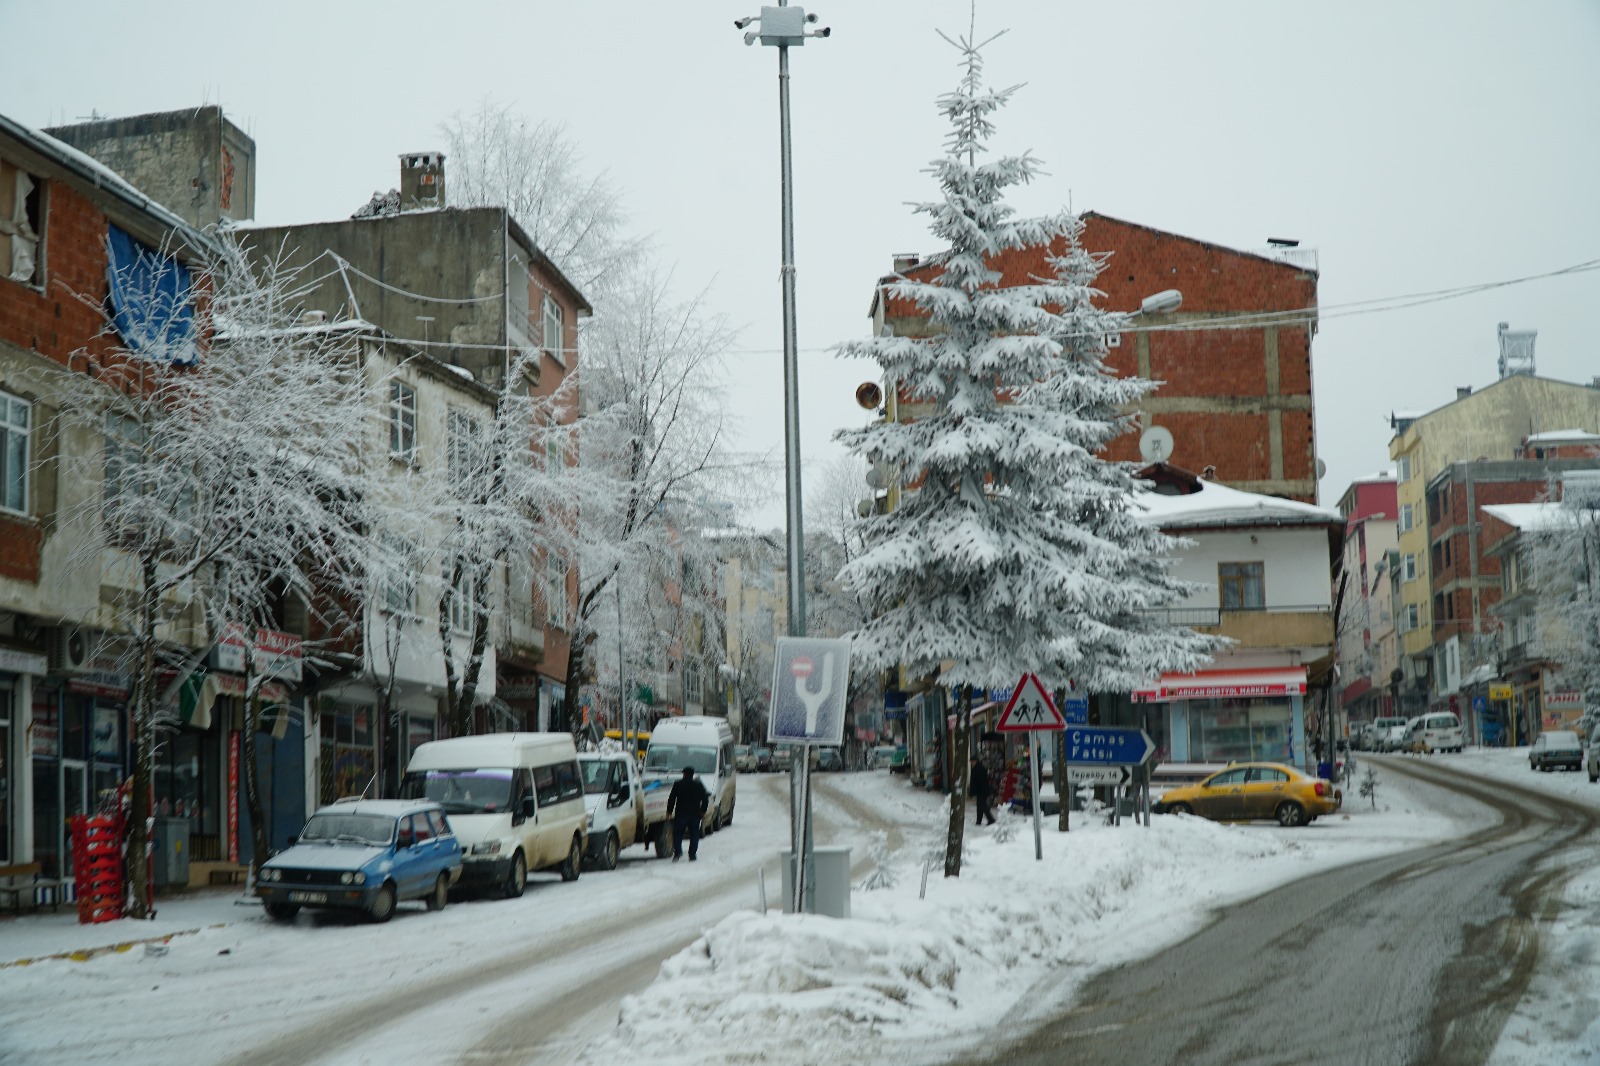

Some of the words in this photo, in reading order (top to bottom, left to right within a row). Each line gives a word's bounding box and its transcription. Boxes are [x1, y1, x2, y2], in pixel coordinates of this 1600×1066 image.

[1240, 685, 1270, 695] MARKET
[1073, 731, 1125, 746] Çamaş
[1070, 769, 1106, 781] Tepeköy
[1108, 771, 1117, 780] 14
